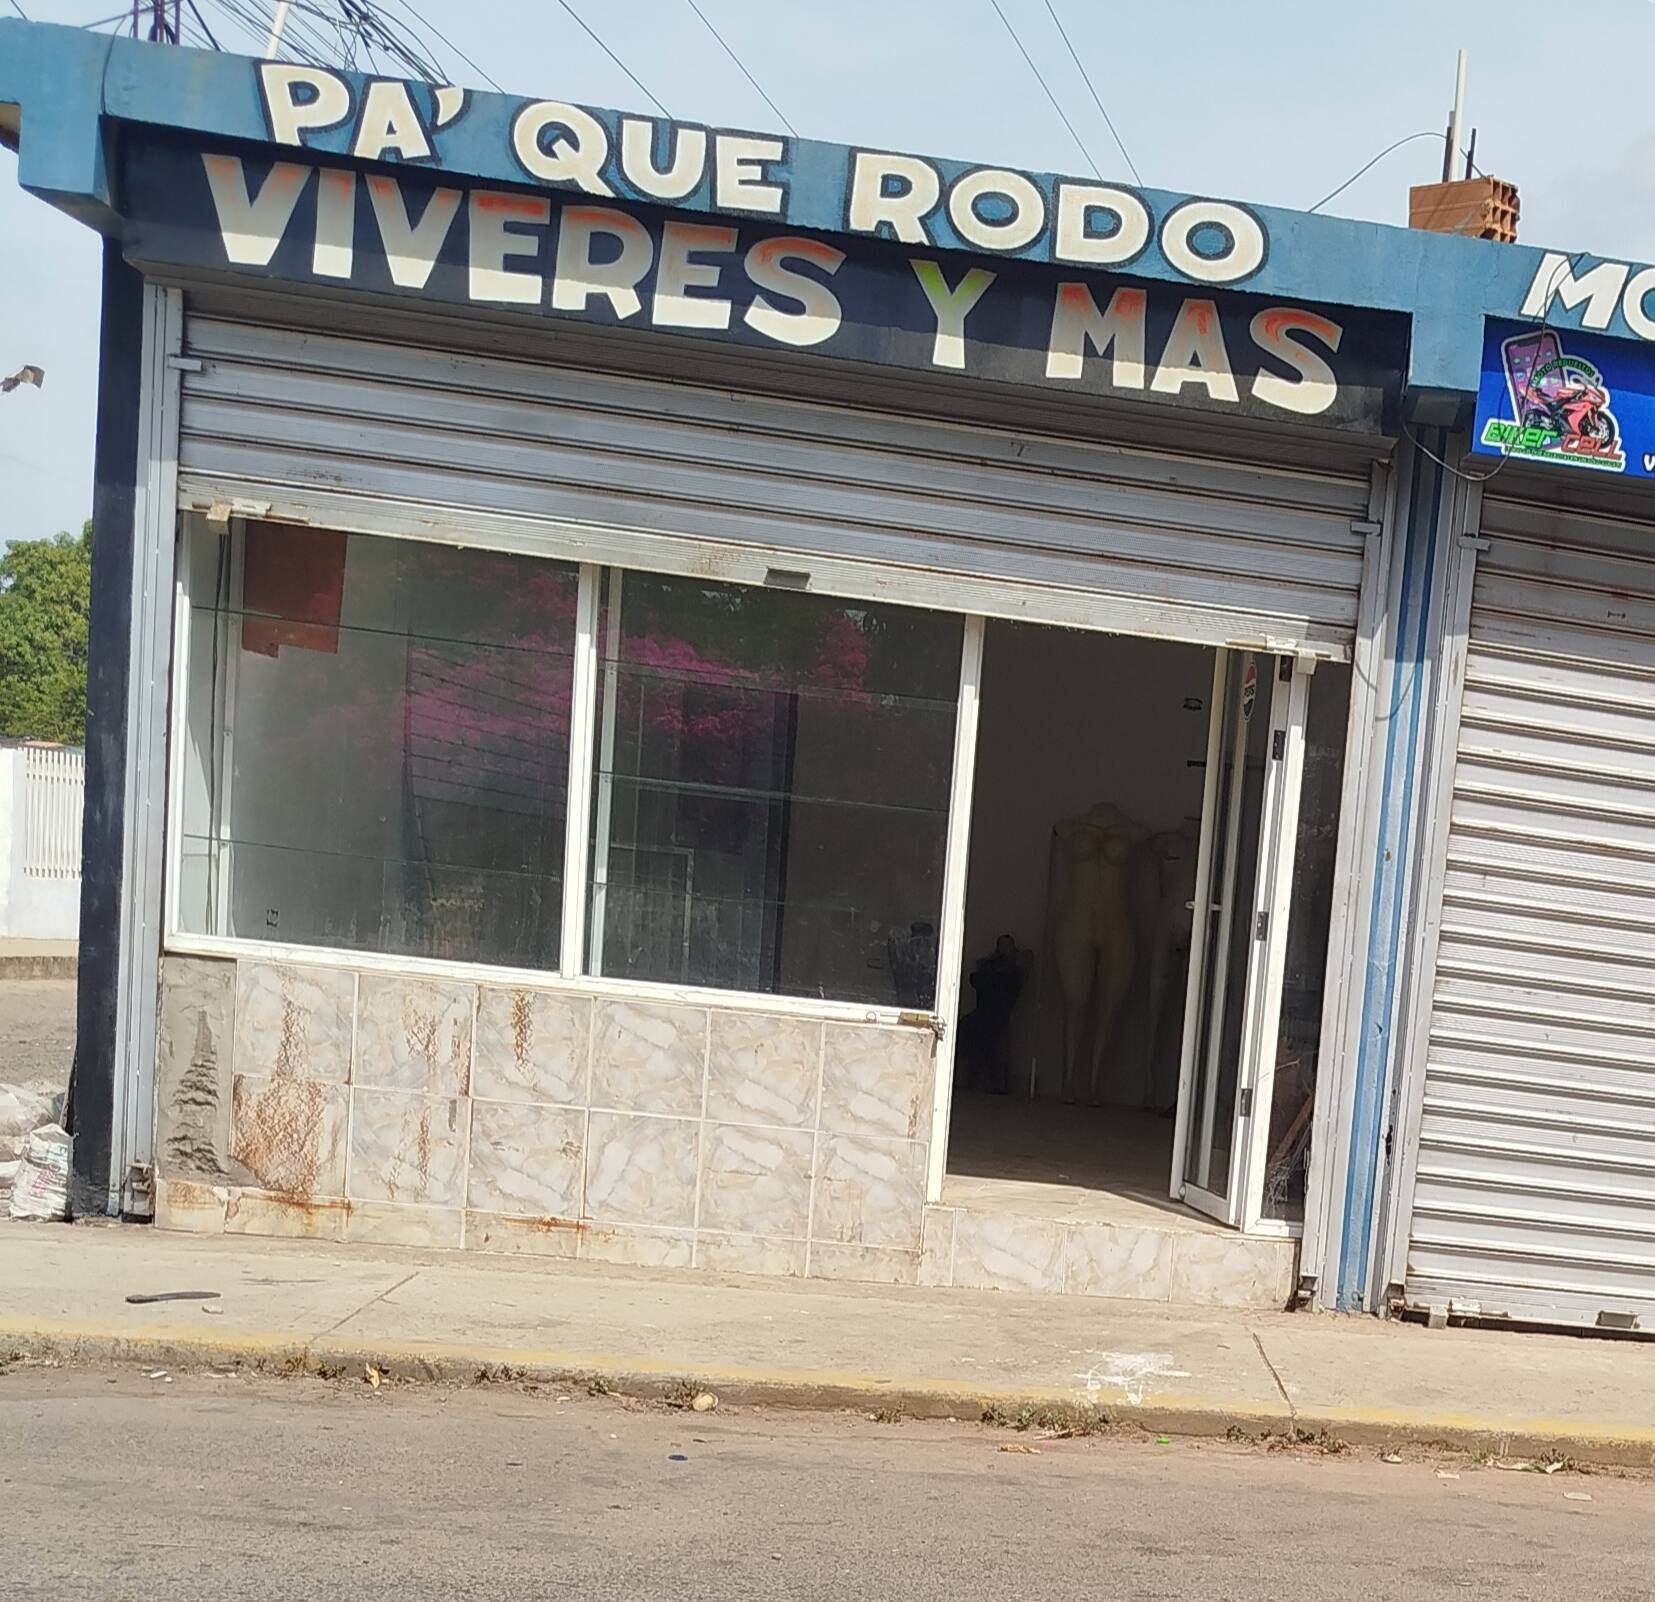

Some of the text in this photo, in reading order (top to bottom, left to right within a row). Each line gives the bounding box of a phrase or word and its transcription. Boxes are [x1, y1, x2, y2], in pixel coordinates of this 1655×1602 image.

[201, 153, 1344, 415] VIVERES Y MAS
[261, 64, 1265, 283] PA' QUE RODO
